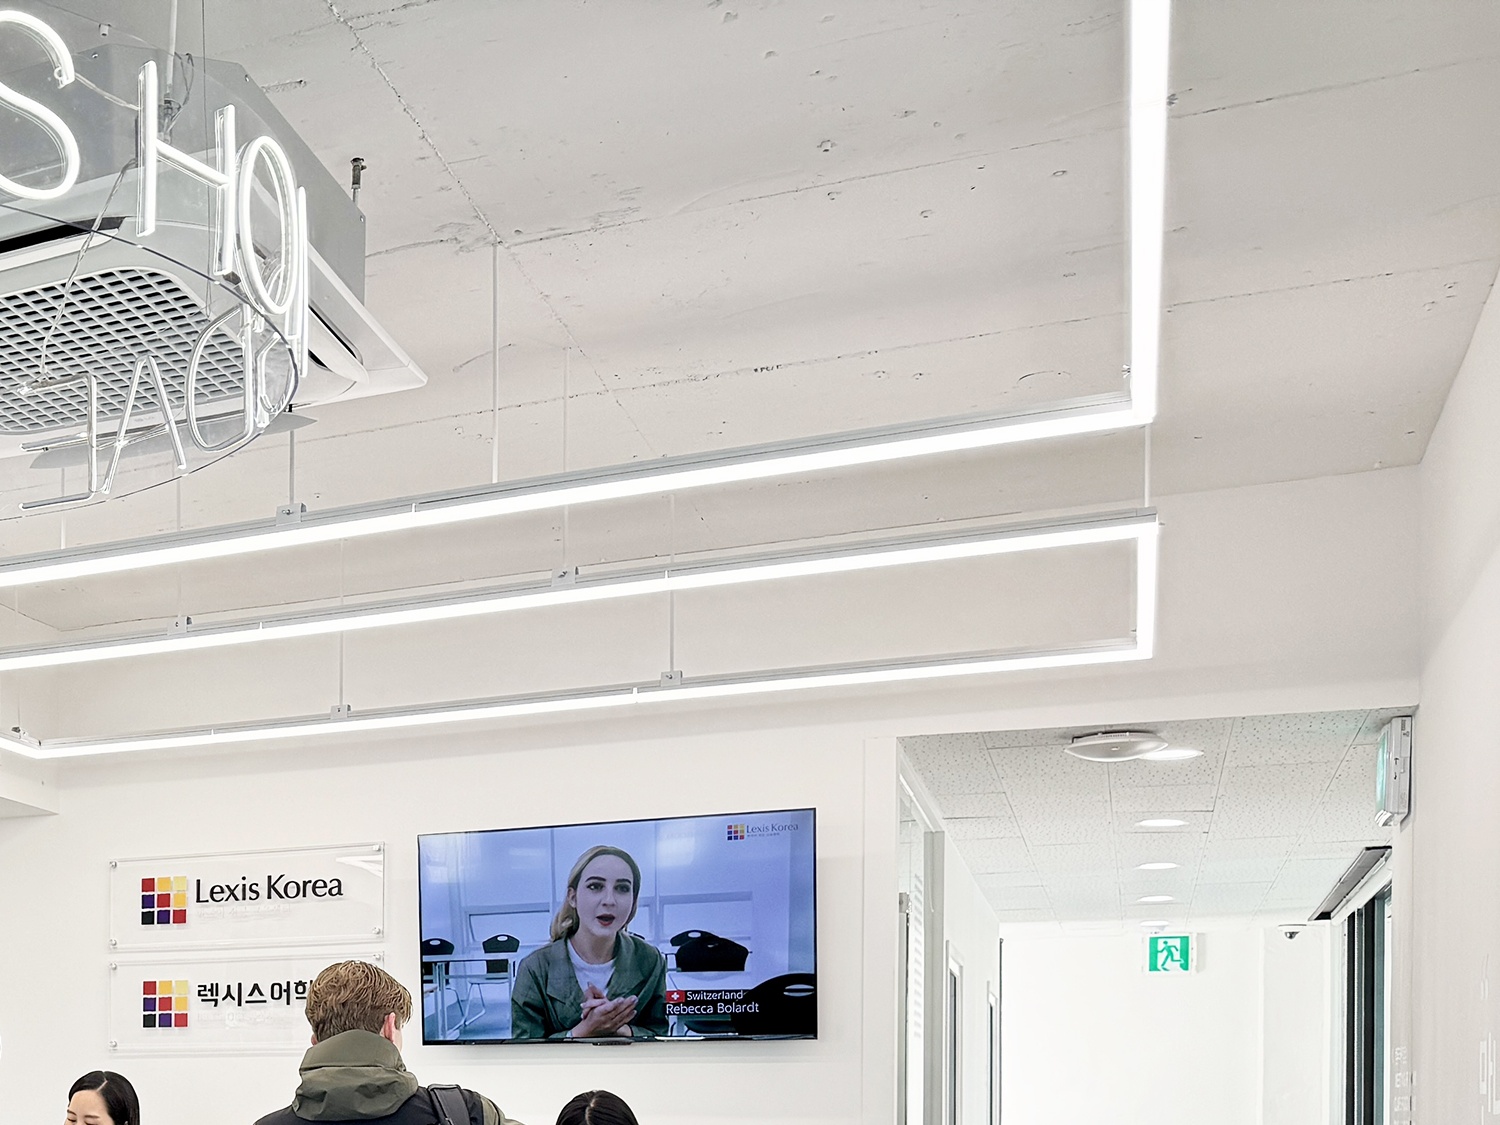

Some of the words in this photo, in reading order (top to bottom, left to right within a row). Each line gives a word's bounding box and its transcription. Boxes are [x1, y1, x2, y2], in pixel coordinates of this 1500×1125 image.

[746, 824, 770, 833] Lexis
[771, 823, 799, 832] Korea
[195, 875, 260, 903] Lexis
[266, 873, 344, 900] Korea
[686, 990, 744, 1001] Switzerland
[666, 1003, 714, 1015] Rebecca
[717, 1001, 760, 1014] Bolardt
